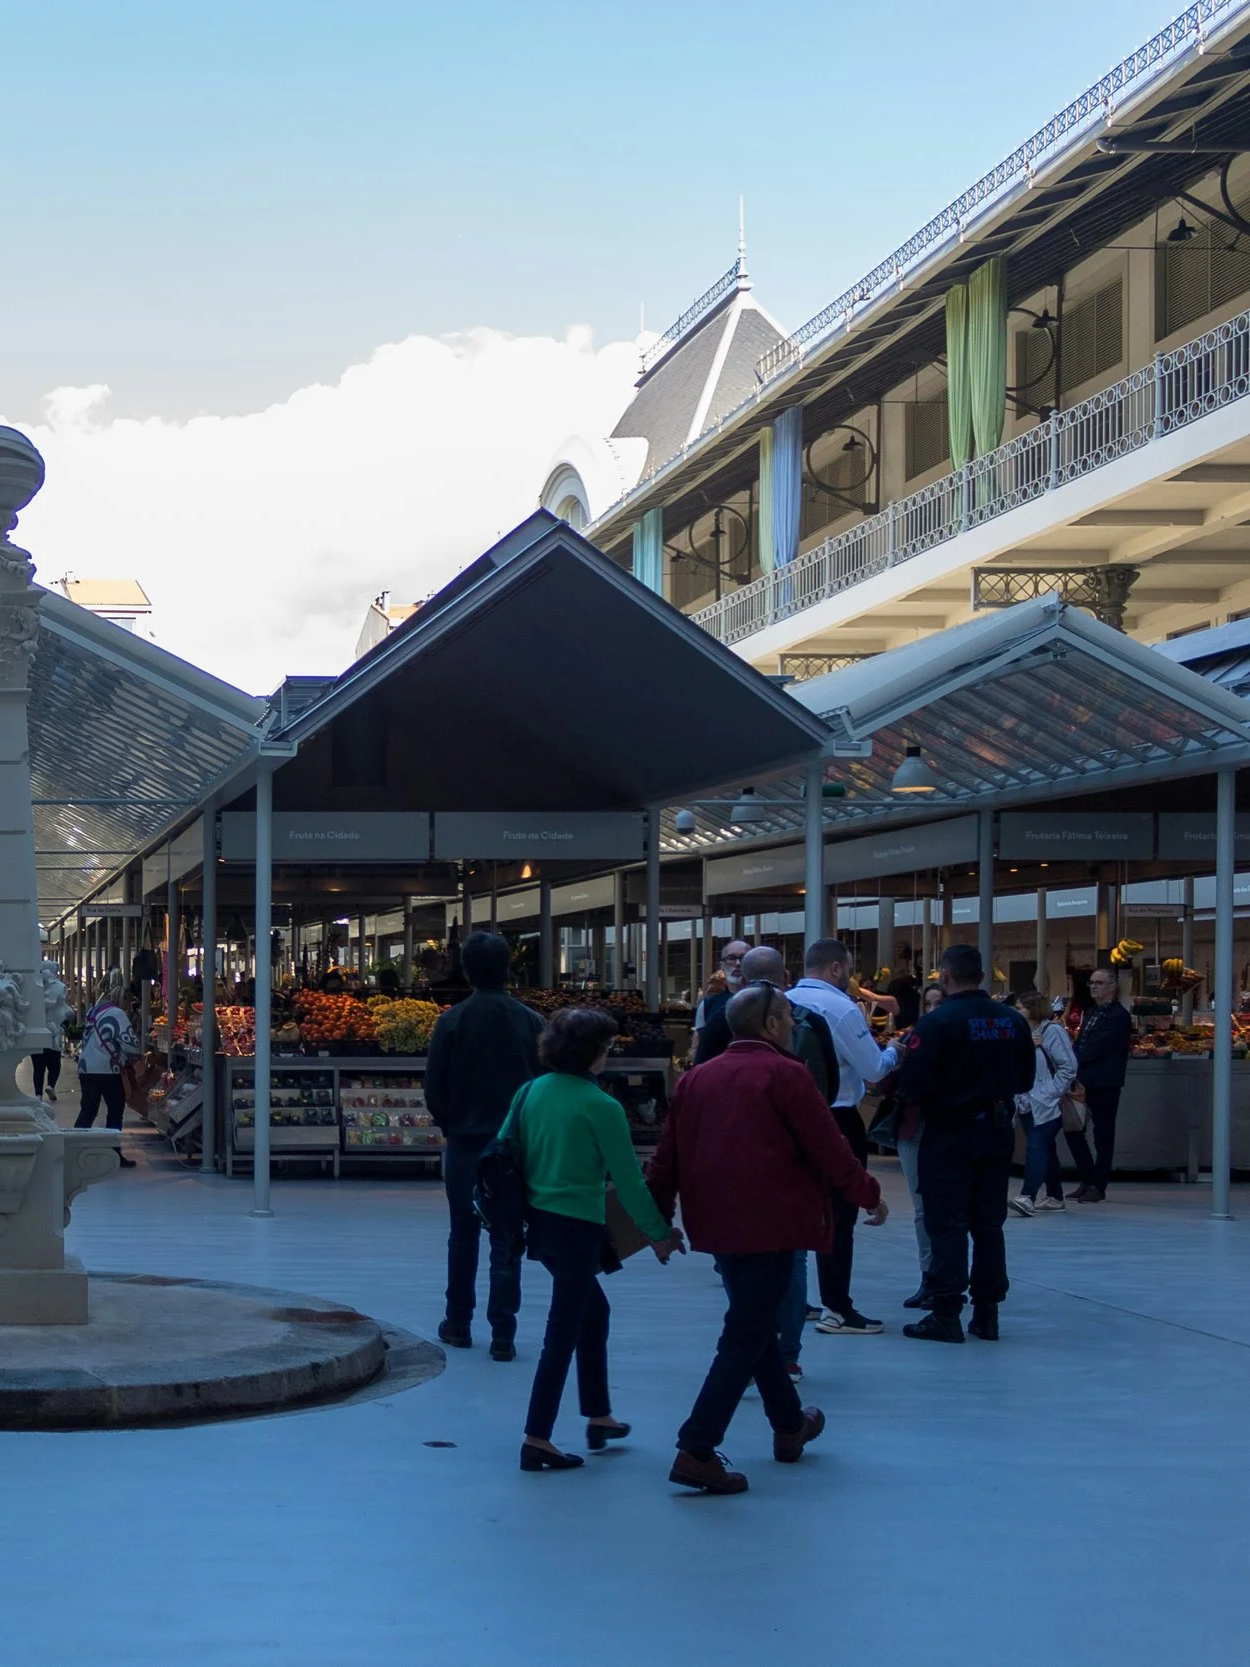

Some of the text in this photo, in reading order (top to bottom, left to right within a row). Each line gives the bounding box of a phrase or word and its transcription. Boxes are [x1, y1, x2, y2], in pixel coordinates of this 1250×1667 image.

[289, 831, 313, 840] Fruta
[326, 831, 360, 840] Cidade
[503, 831, 526, 840] Fruta
[540, 831, 574, 840] Cidade
[1025, 830, 1129, 840] Frutaria Fátima Teixeira
[968, 1017, 1013, 1028] STRONG
